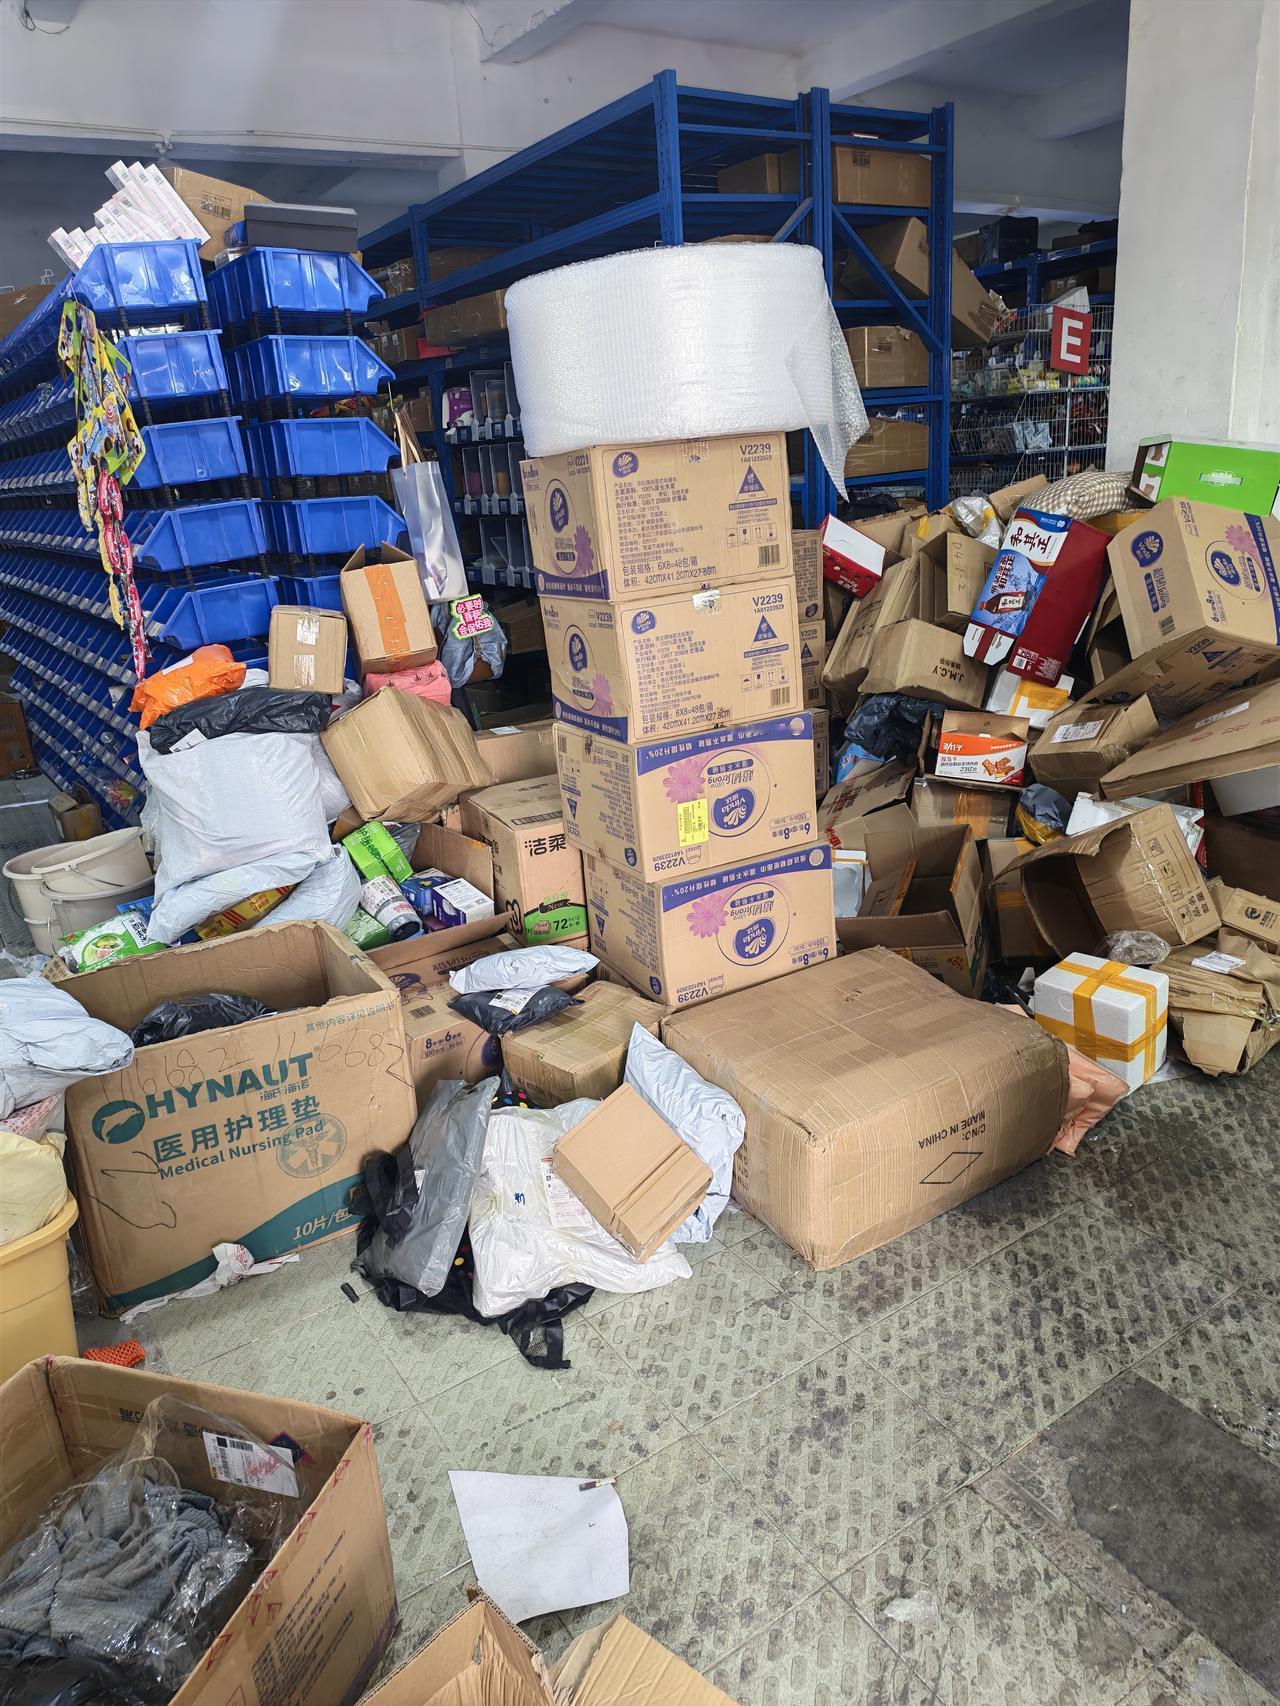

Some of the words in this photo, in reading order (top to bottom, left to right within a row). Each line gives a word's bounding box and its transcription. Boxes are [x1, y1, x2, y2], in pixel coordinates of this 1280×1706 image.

[1060, 318, 1083, 363] E
[740, 443, 771, 455] V2239
[1010, 526, 1052, 554] 和其正
[752, 593, 783, 606] V2239
[708, 772, 731, 786] Strong
[721, 796, 746, 813] Vinda
[524, 834, 567, 857] 洁柔
[654, 857, 687, 871] V2239
[730, 901, 752, 917] Strong
[553, 919, 569, 932] 72
[742, 926, 767, 944] Vinda
[677, 987, 709, 1003] V2239
[305, 1002, 395, 1034] 其他内容详见说明书
[145, 1052, 314, 1119] HYNAUT
[259, 1080, 310, 1102] 海氏海诺
[152, 1094, 321, 1163] 医用护理垫
[961, 1110, 985, 1130] MADE
[949, 1124, 960, 1136] IN
[918, 1130, 948, 1149] CHINA
[158, 1151, 226, 1180] Medical
[229, 1132, 293, 1161] Nursing
[295, 1120, 324, 1138] Pad
